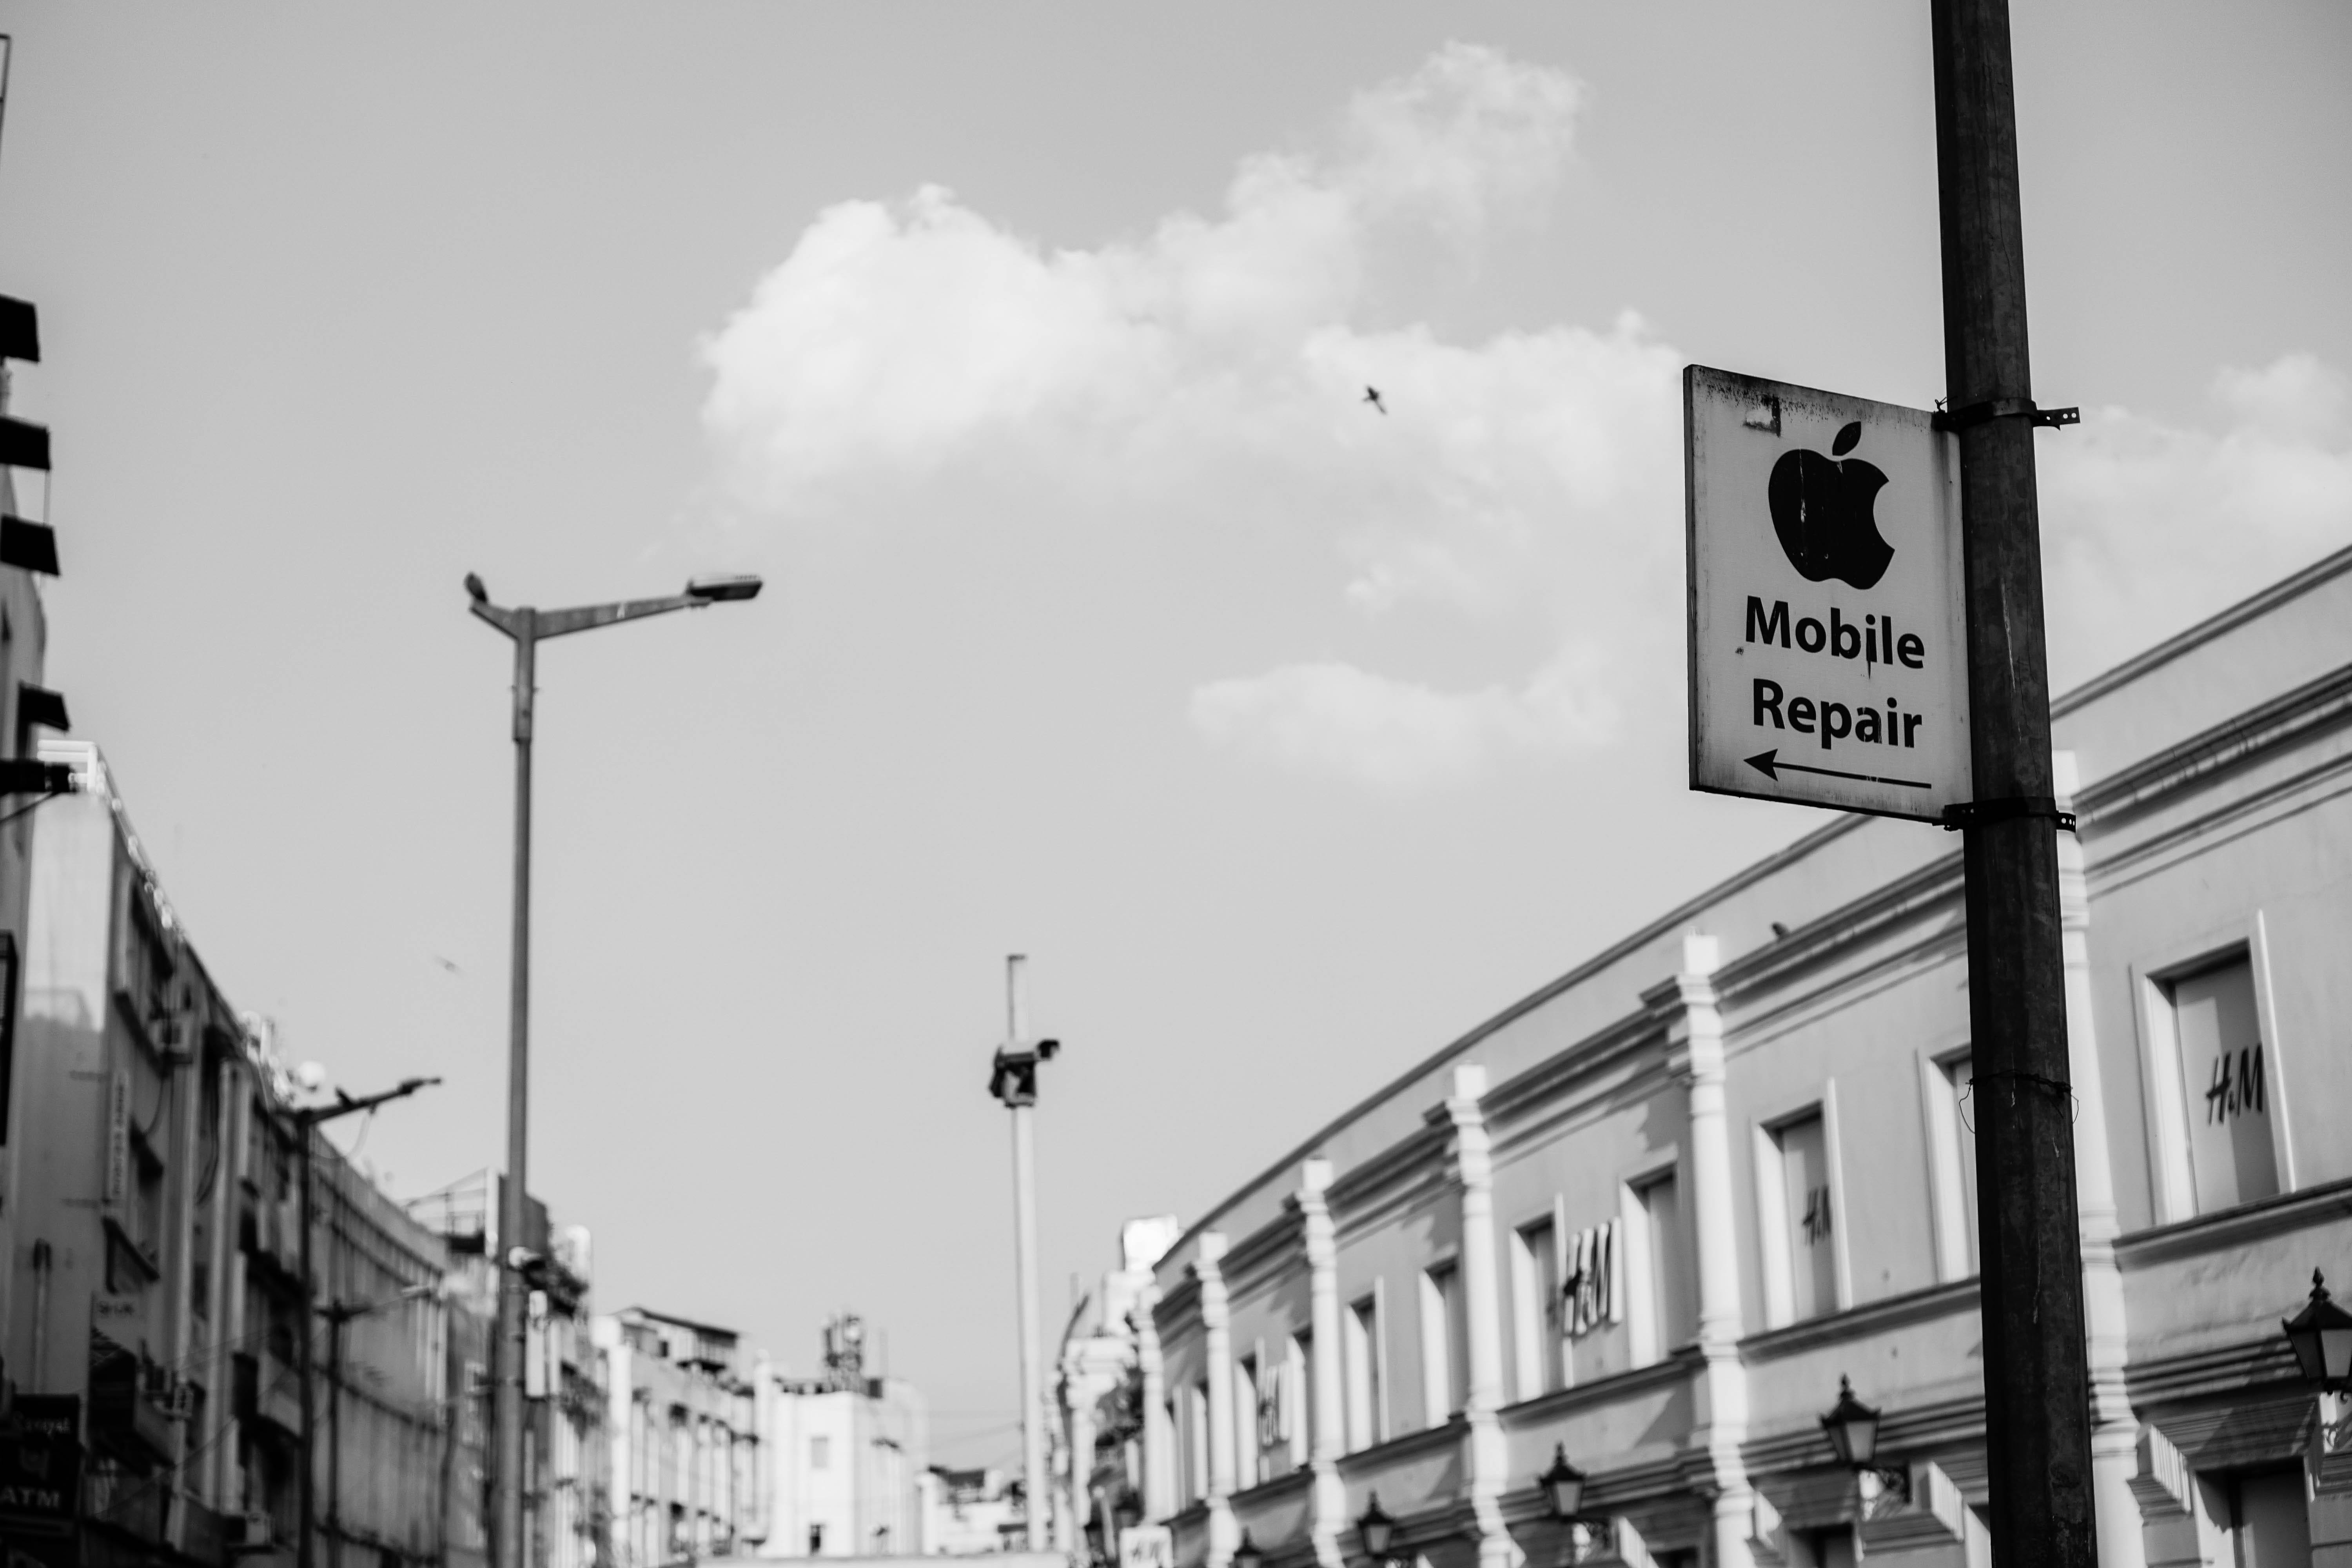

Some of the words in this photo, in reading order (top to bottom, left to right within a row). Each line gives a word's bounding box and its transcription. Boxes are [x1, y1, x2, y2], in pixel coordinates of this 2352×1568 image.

[1746, 595, 1925, 669] Mobile
[1753, 678, 1922, 750] Repair
[0, 1484, 61, 1510] ATM
